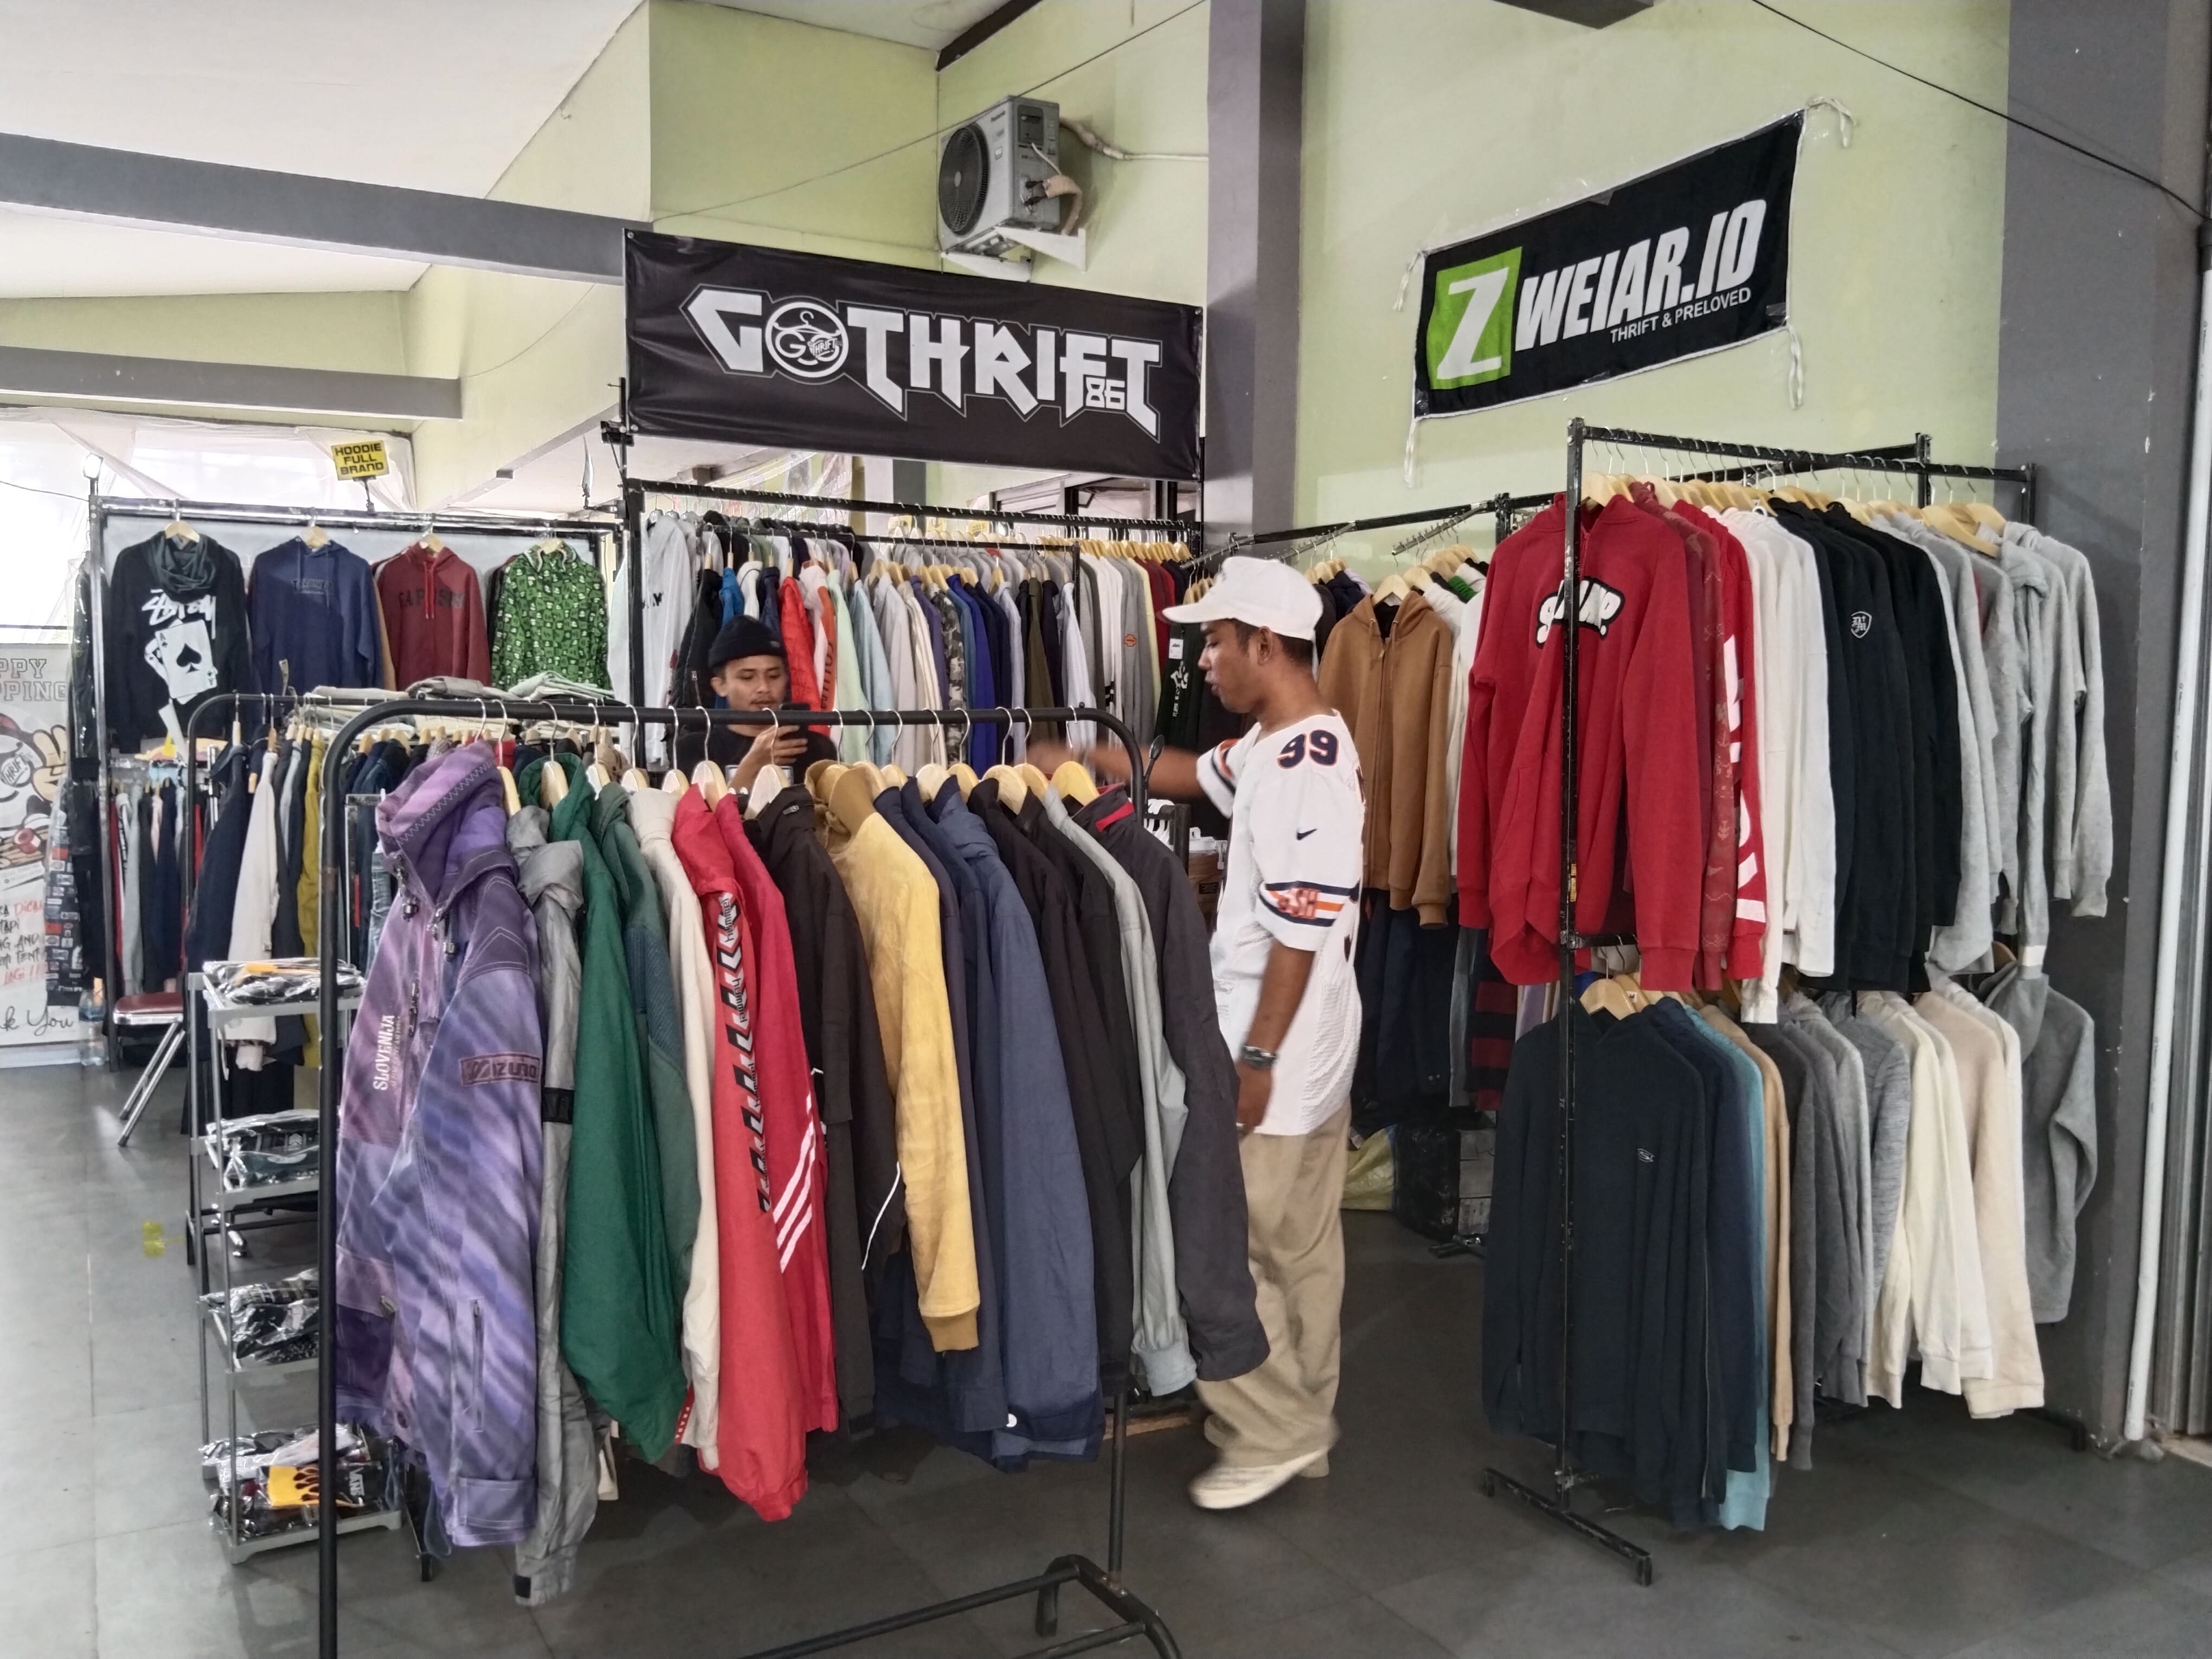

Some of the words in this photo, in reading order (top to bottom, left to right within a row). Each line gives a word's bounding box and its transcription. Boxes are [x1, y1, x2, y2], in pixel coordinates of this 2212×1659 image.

[1610, 315, 1660, 344] THRIFT
[1662, 312, 1673, 328] &
[1675, 287, 1752, 325] PRELOVED
[1086, 377, 1125, 410] 86
[335, 443, 382, 456] HOODIE
[343, 454, 377, 465] FULL
[340, 462, 384, 475] BRAND
[1277, 729, 1339, 769] 99
[722, 898, 734, 943] hummel
[732, 977, 748, 1023] hummel
[372, 1014, 395, 1091] SLOVENIJA
[349, 1467, 365, 1496] VANS
